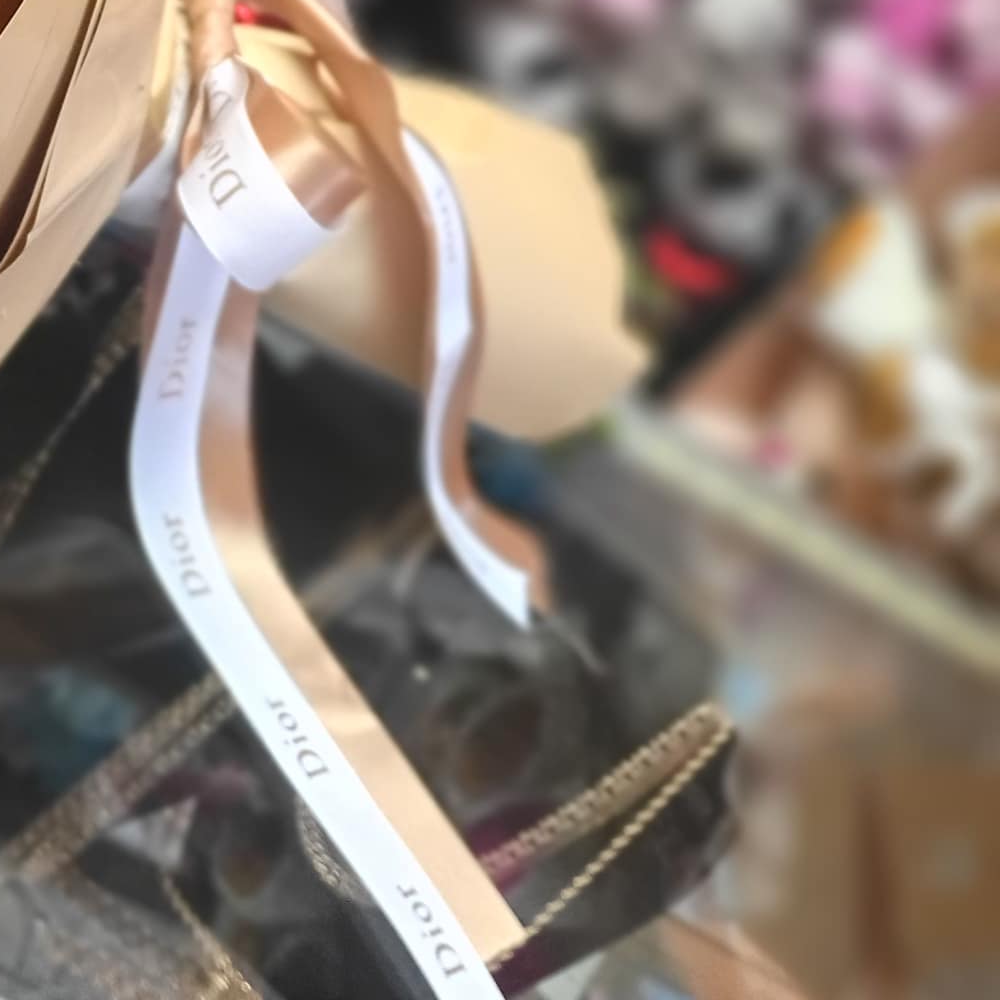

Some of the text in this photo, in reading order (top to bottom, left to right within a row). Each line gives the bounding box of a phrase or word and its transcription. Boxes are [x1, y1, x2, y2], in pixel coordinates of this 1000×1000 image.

[158, 316, 198, 400] Dior
[163, 512, 212, 599] Dior
[265, 695, 330, 781] Dior
[396, 883, 467, 979] Dior
